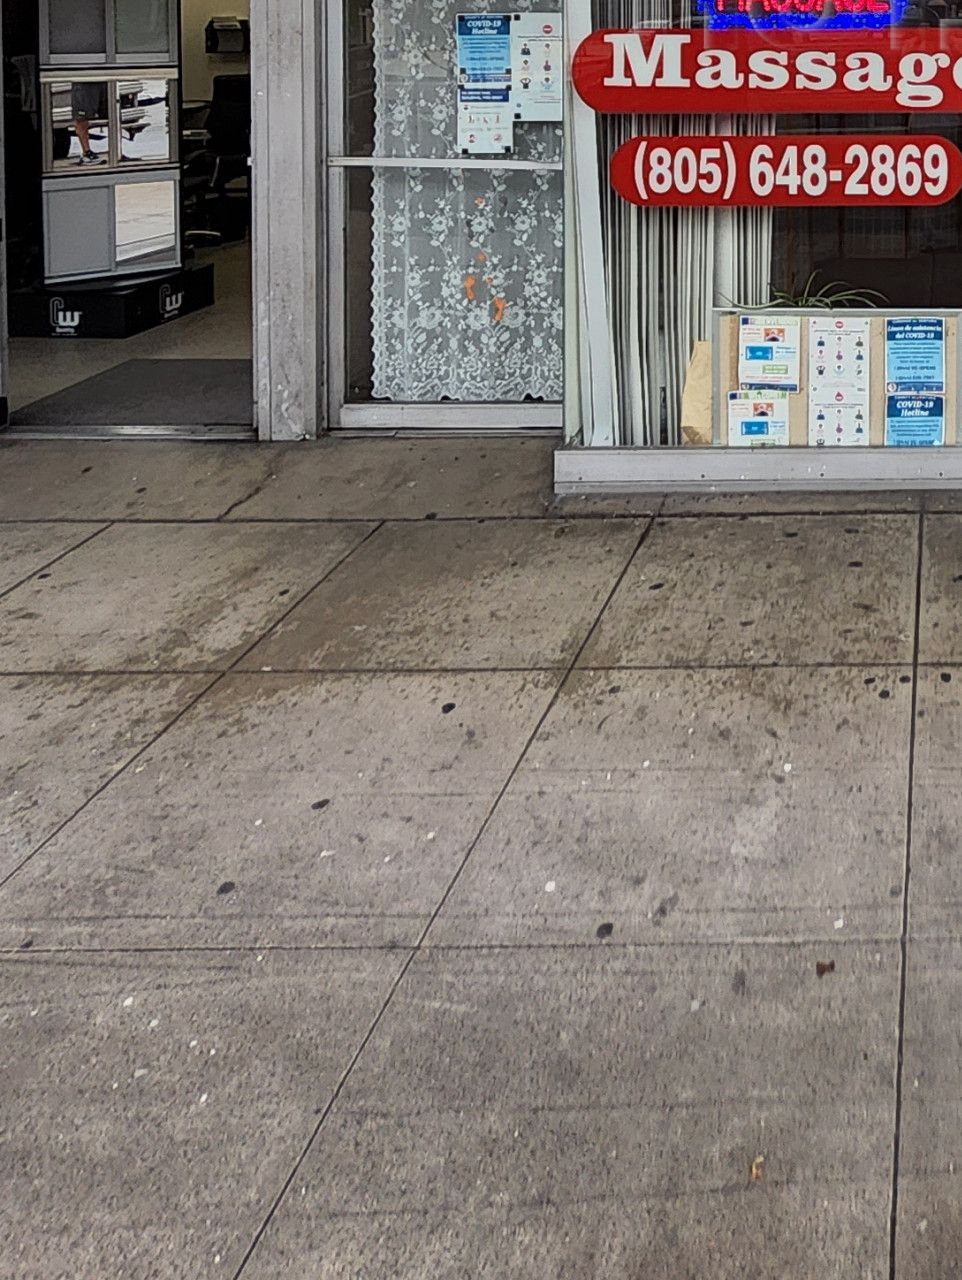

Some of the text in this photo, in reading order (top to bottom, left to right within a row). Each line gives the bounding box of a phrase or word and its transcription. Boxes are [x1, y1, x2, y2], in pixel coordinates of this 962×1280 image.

[467, 20, 501, 28] COVID-19
[633, 141, 949, 199] (805) 648-2869
[896, 400, 934, 409] COVID-19
